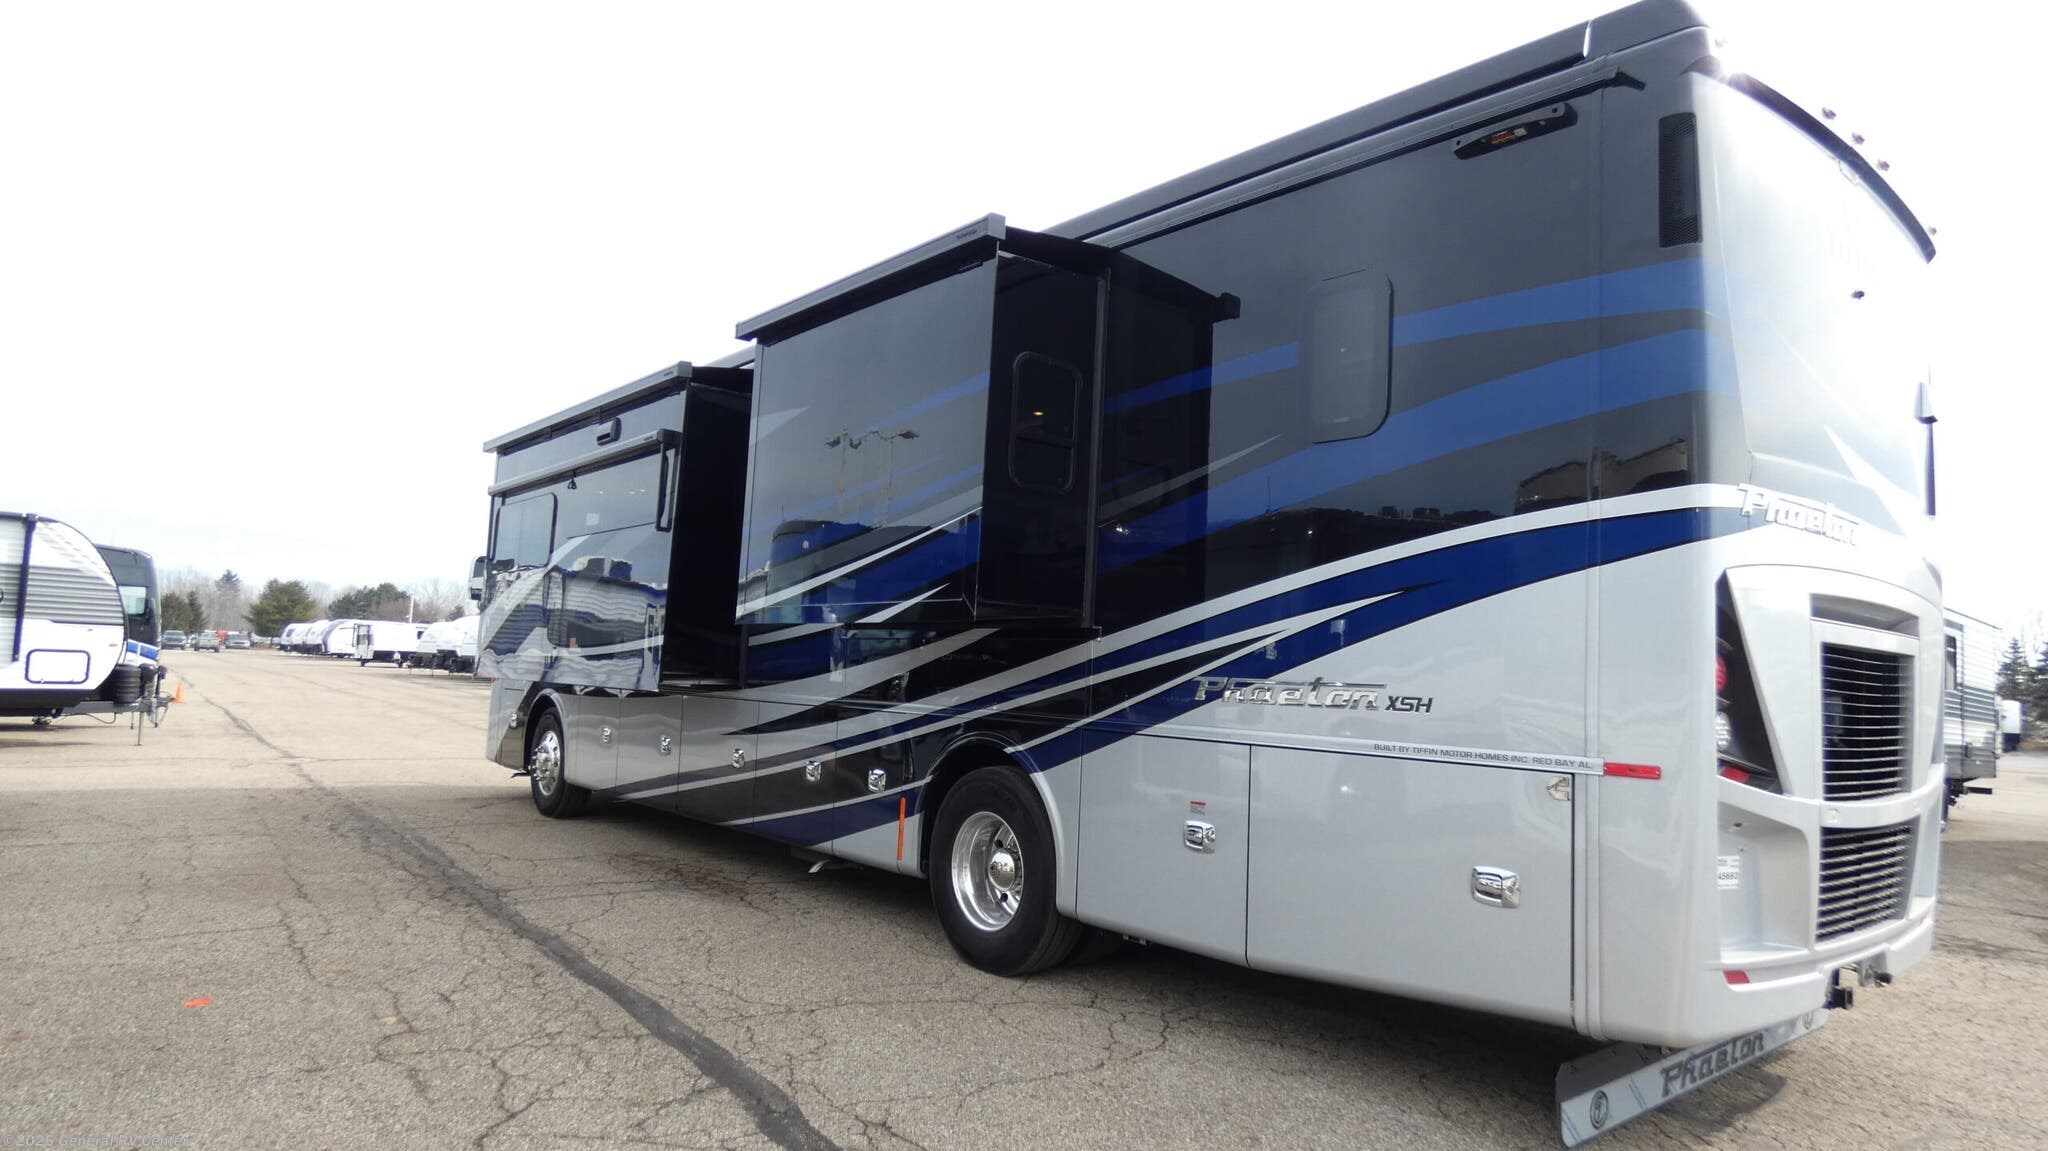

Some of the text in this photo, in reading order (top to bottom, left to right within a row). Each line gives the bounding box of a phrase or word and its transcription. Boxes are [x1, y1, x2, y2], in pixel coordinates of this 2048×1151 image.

[1194, 677, 1433, 713] Phaeton XSH
[1374, 743, 1397, 752] BUILT
[1398, 745, 1410, 753] BY
[1412, 746, 1438, 756] TIFFIN
[1440, 749, 1472, 759] MOTOR
[1474, 752, 1508, 762] HOMES
[1510, 755, 1530, 764] INC.
[1532, 757, 1553, 766] RED
[1554, 759, 1576, 767] BAY
[1660, 1031, 1764, 1098] Phaeton
